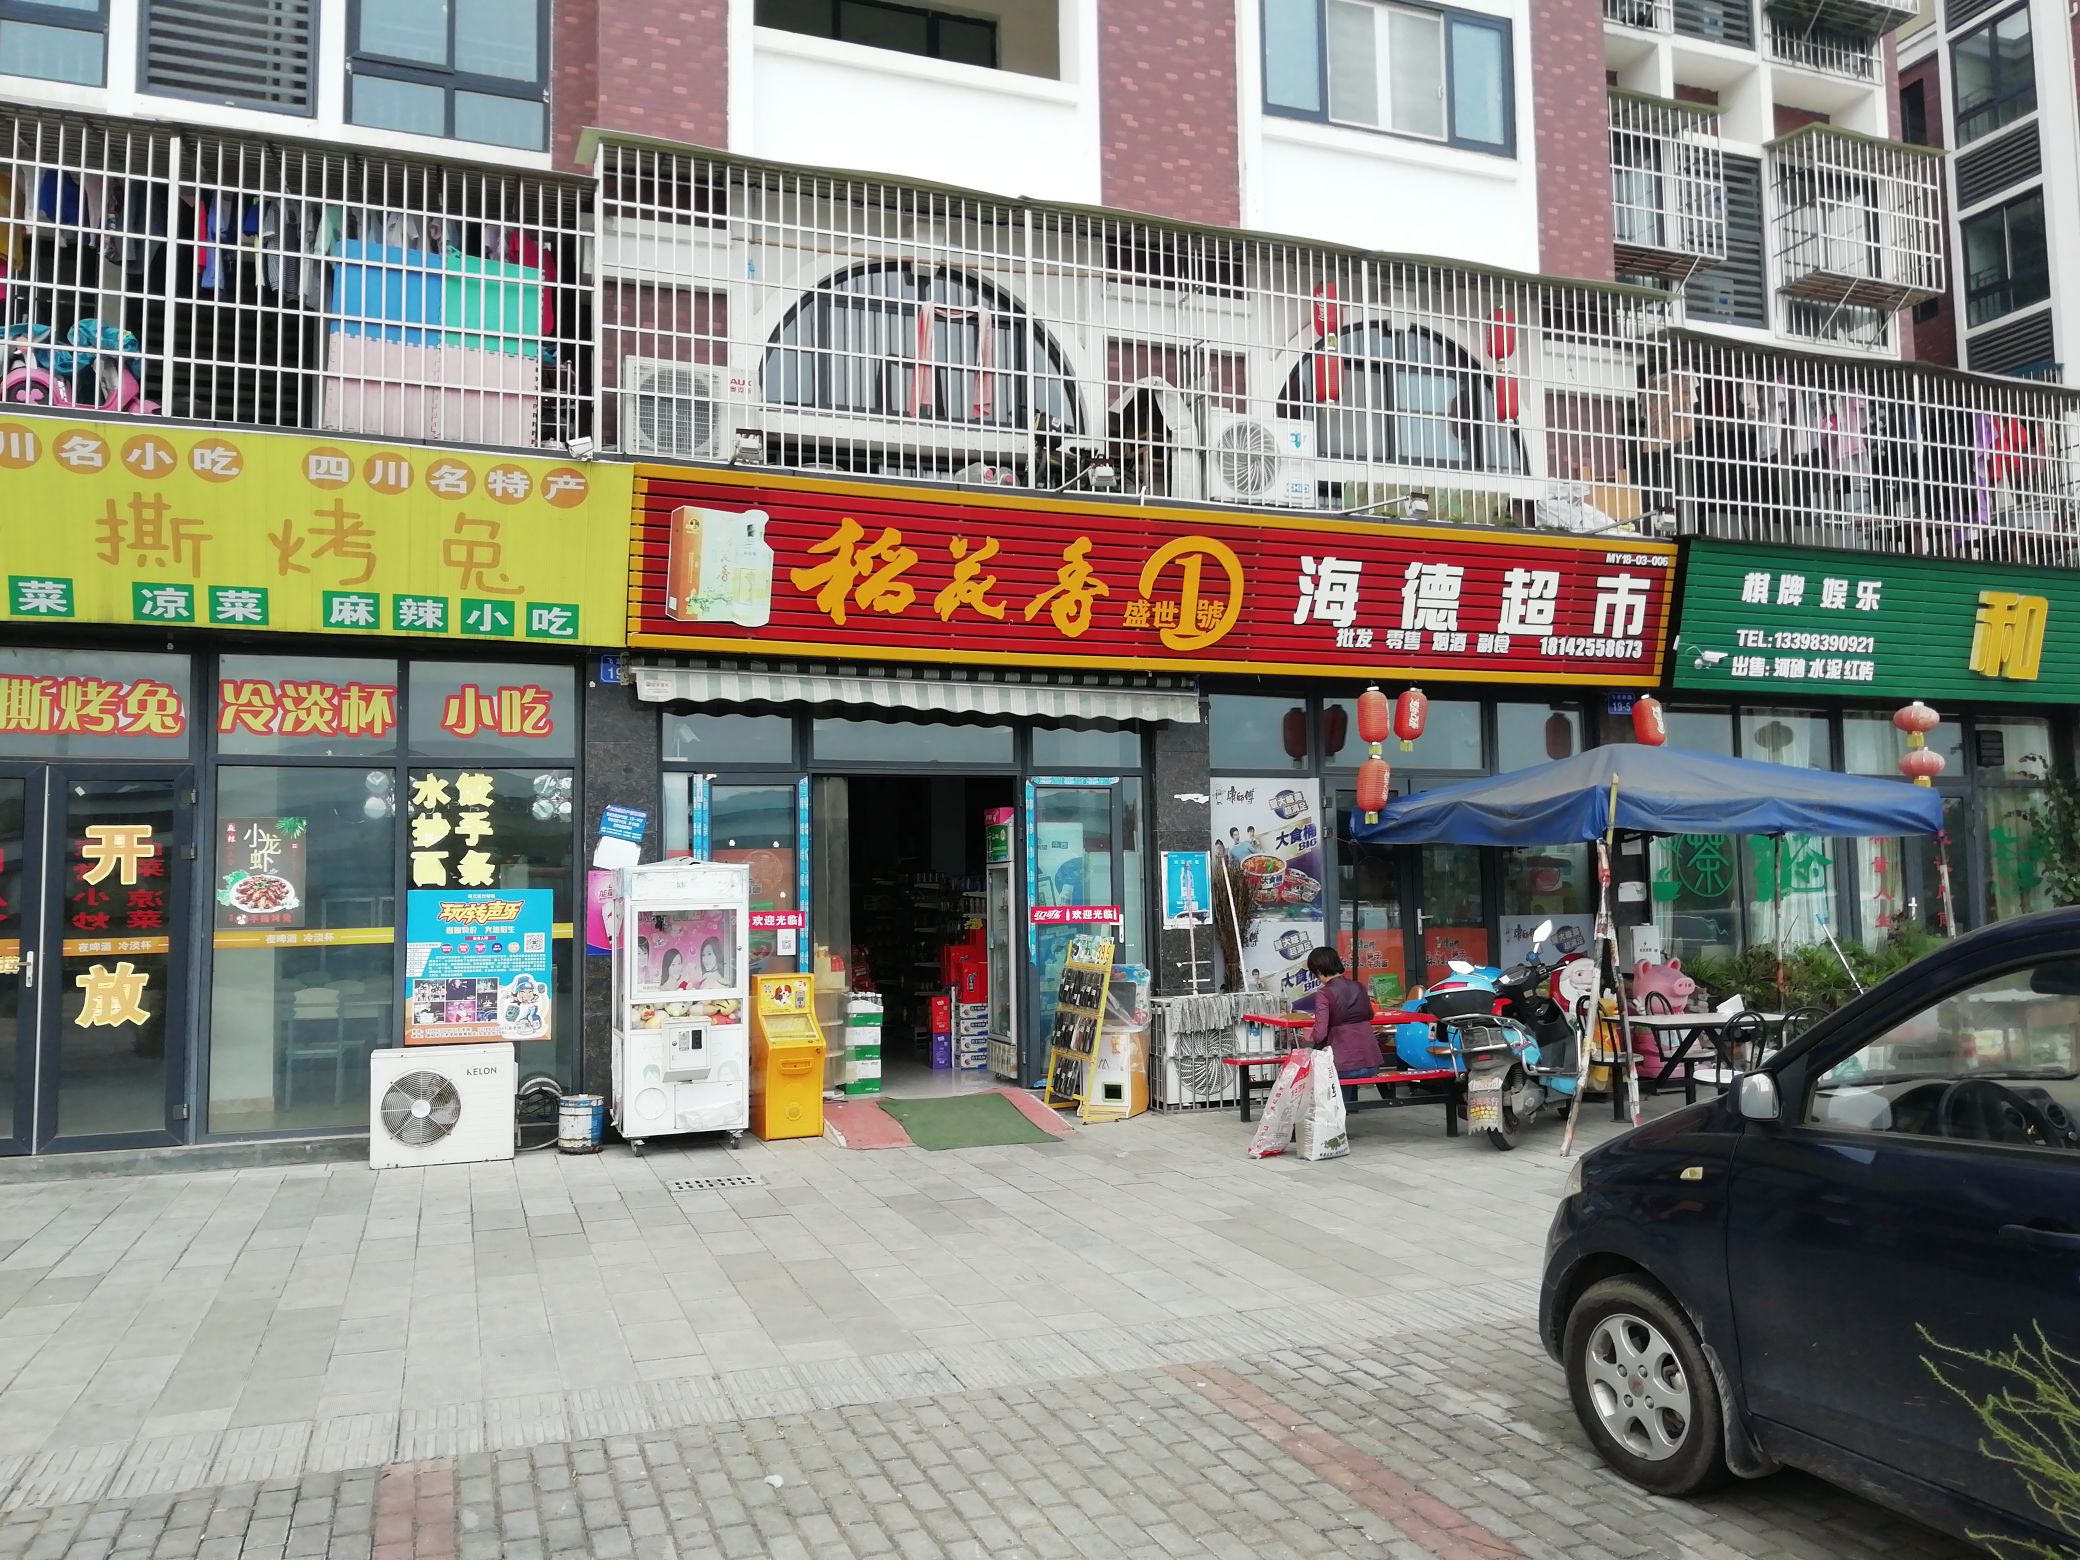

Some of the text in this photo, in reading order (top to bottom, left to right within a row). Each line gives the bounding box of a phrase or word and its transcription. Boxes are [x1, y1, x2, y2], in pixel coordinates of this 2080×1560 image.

[309, 454, 586, 500] 四川名特产
[95, 492, 525, 595] 撕烤兔
[1605, 553, 1669, 567] MY18-03-006
[1293, 555, 1652, 639] 海德超市
[1741, 571, 1883, 612] 棋牌 娱乐
[18, 581, 574, 636] 菜 凉菜 麻辣小吃
[1336, 628, 1511, 654] 批发 零售 烟酒 副食
[1539, 636, 1643, 659] 18142558673
[1736, 629, 1875, 654] TEL:13398390921
[1969, 591, 2049, 680] 和
[1731, 655, 1770, 678] 出售:
[1808, 658, 1843, 680] 水泥
[1843, 659, 1875, 682] 红砖
[0, 675, 186, 737] 撕烤兔
[219, 679, 398, 737] 冷淡杯
[442, 683, 553, 737] 小吃
[1612, 702, 1631, 712] 19-5
[1275, 823, 1317, 850] 大食桶
[752, 914, 799, 927] 欢迎光临
[1072, 910, 1113, 921] 欢迎光临
[118, 940, 153, 951] 冷淡杯
[466, 1066, 497, 1077] KELON
